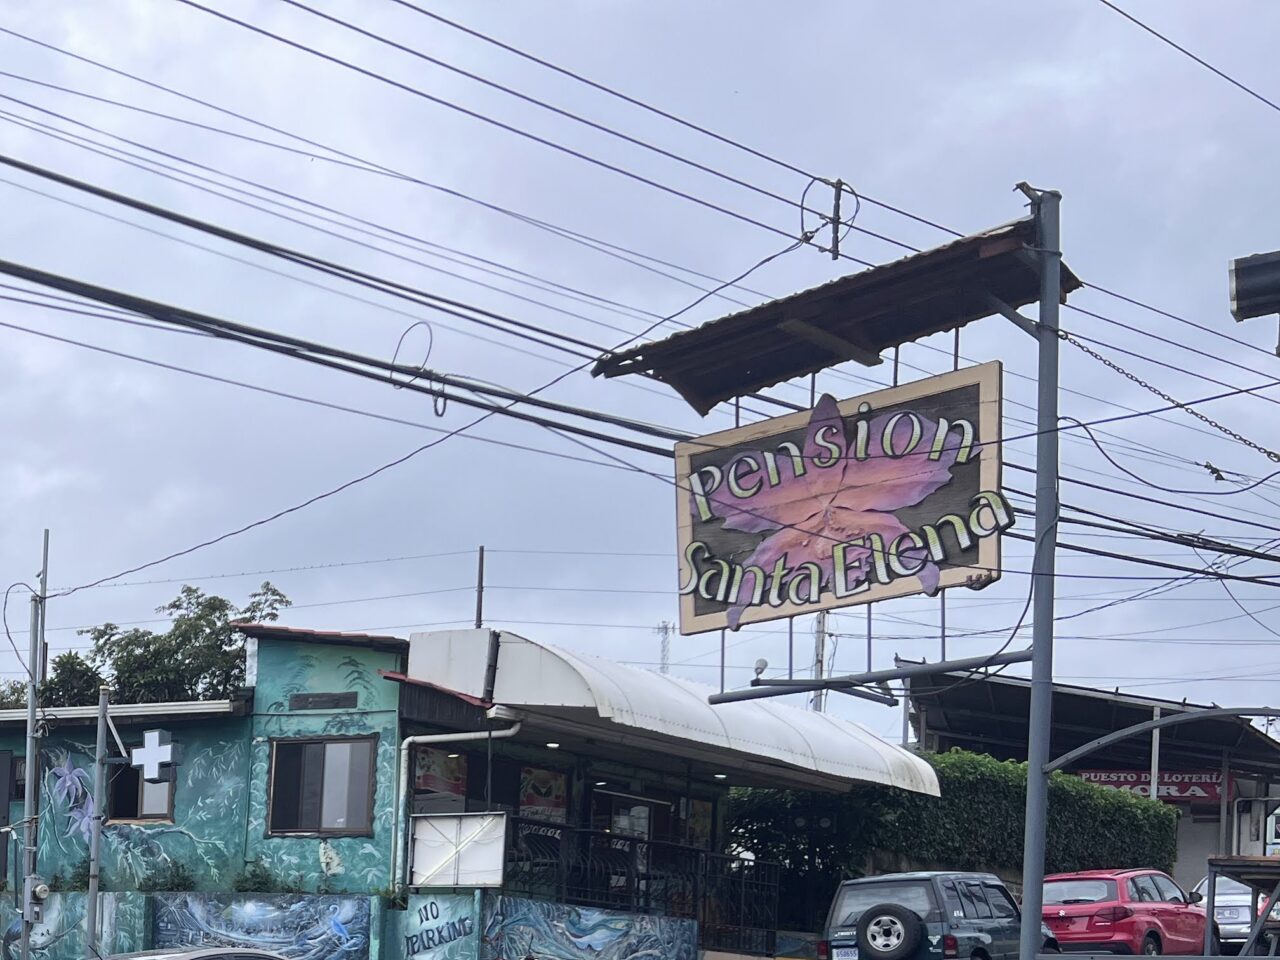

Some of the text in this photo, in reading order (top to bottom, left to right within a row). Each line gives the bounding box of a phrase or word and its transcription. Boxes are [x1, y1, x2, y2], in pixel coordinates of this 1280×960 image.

[680, 489, 1014, 606] Santa Elena
[1081, 772, 1137, 782] PUESTO
[1141, 773, 1159, 782] D
[418, 902, 439, 925] NO
